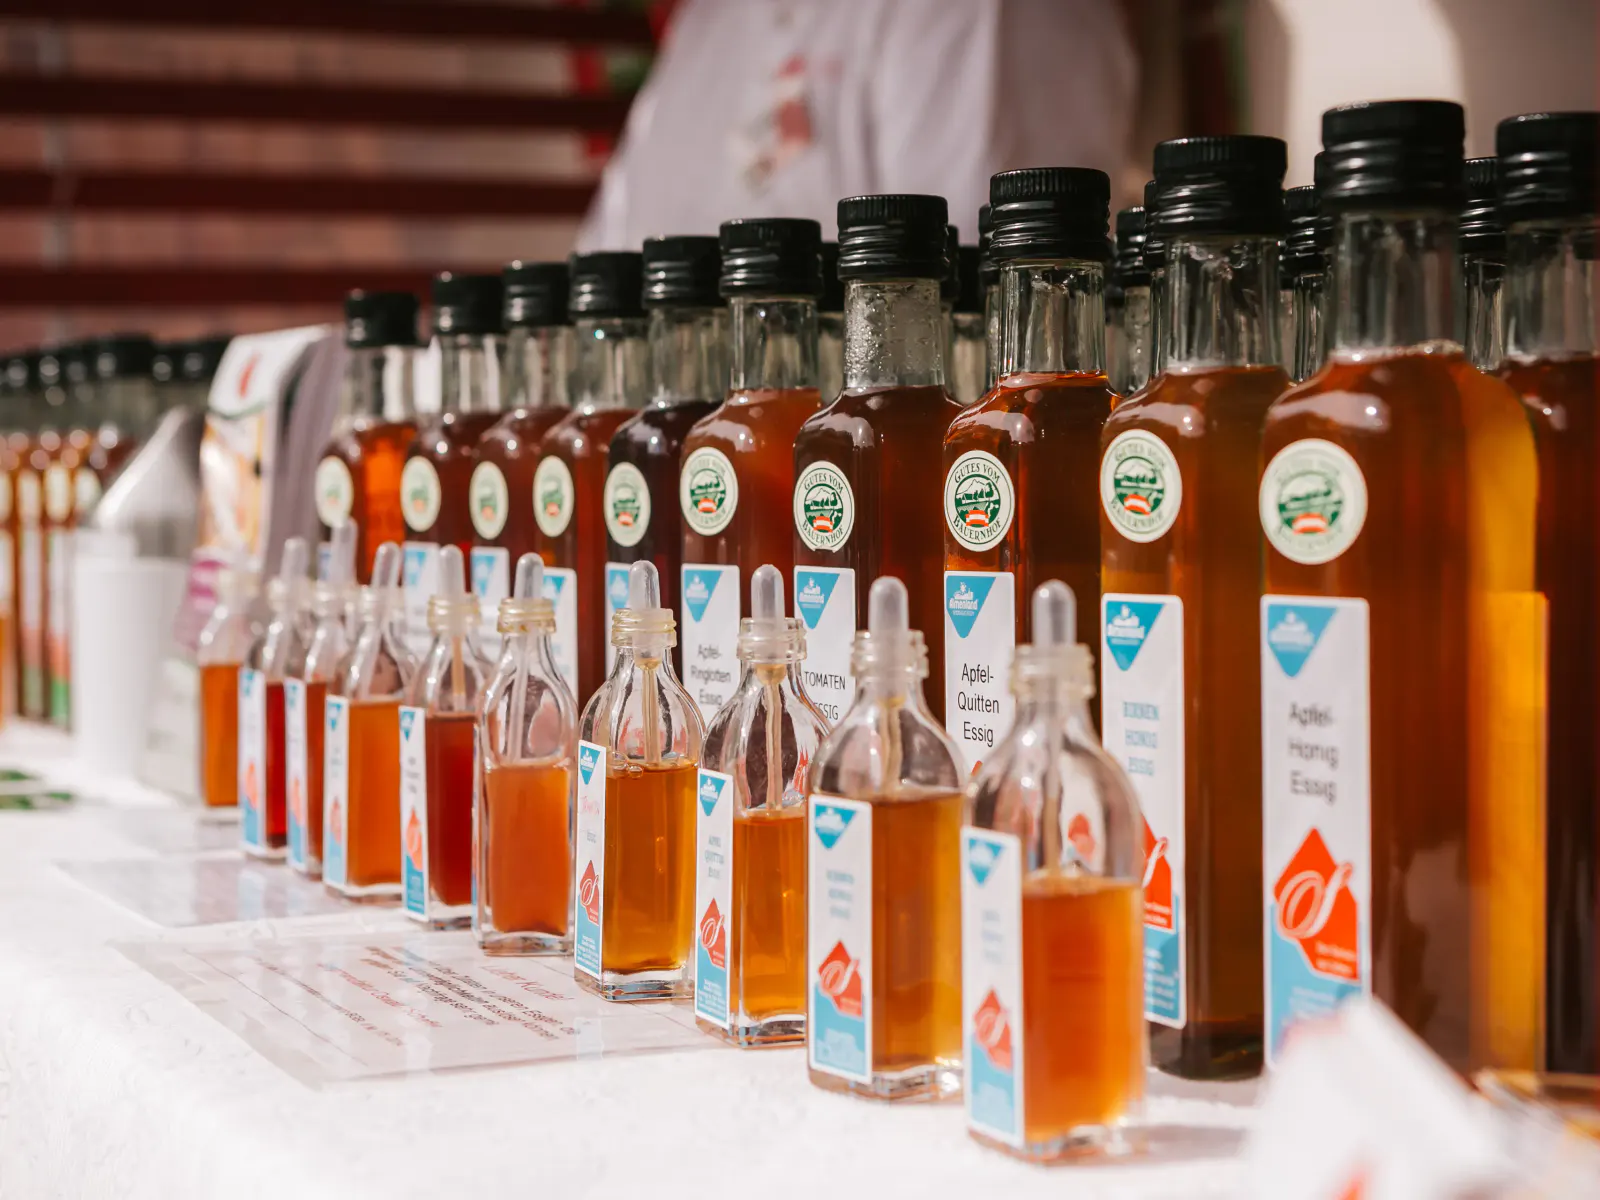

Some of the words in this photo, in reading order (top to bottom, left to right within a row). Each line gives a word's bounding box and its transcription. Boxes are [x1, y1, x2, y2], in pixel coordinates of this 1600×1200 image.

[804, 473, 827, 491] GUTES
[829, 474, 844, 494] VOM
[954, 463, 980, 484] GUTES
[983, 463, 1000, 484] VOM
[802, 519, 844, 545] BAUERNHOF
[953, 515, 1001, 541] BAUERNHOF
[804, 671, 846, 690] TOMATEN
[961, 663, 994, 686] Apfel-
[813, 702, 839, 721] SSIG
[957, 691, 1000, 714] Quitten
[963, 721, 994, 748] Essig
[1288, 738, 1339, 770] Honig
[1290, 770, 1337, 805] Essig
